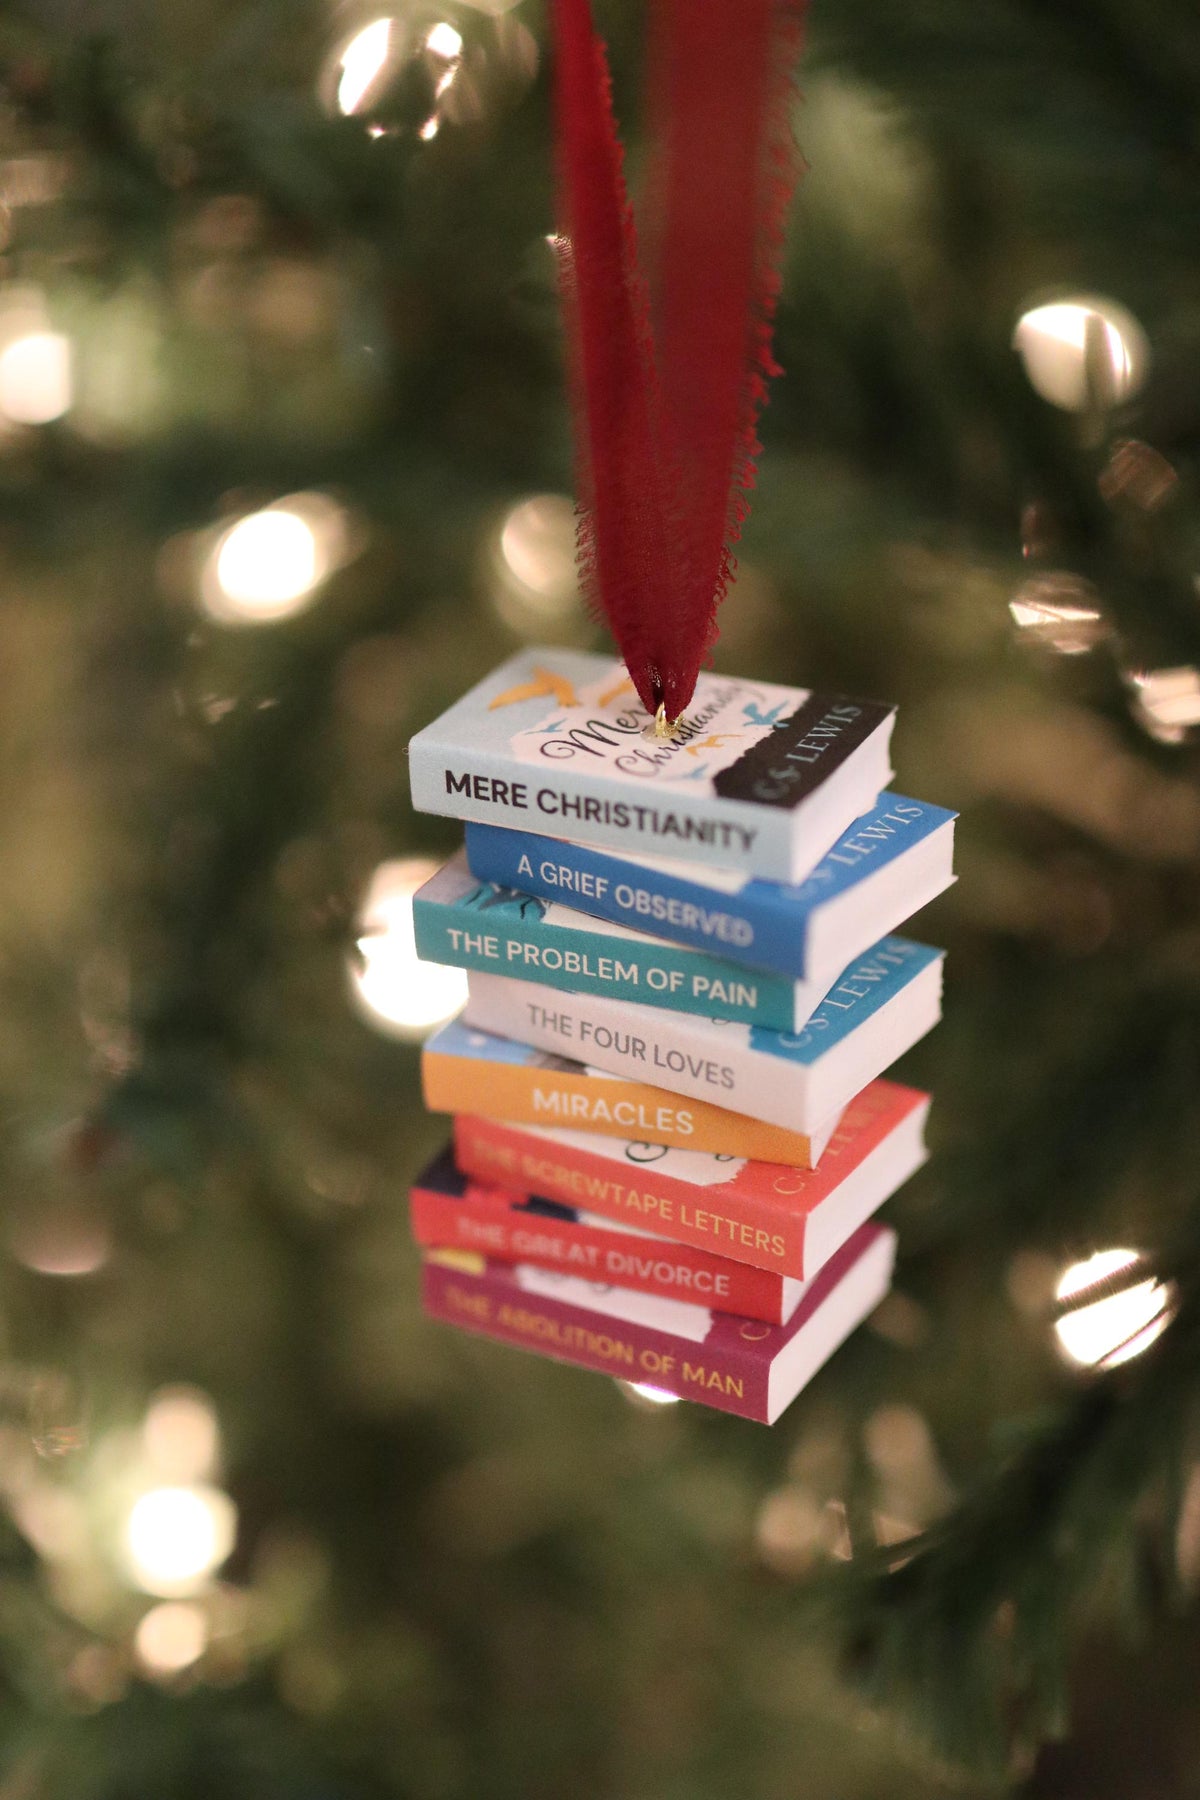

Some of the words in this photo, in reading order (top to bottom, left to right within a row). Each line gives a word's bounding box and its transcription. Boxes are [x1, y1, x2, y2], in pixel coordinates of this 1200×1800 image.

[540, 700, 646, 759] Mer
[785, 705, 861, 763] LEWIS
[445, 769, 528, 809] MERE
[536, 788, 757, 852] CHRISTIANITY
[826, 804, 924, 866] LEWIS
[517, 854, 534, 878] A
[540, 862, 609, 899] GRIEF
[614, 885, 754, 947] OBSERVED
[447, 928, 500, 959] THE
[506, 940, 639, 985] PROBLEM
[646, 968, 685, 992] OF
[692, 975, 757, 1008] PAIN
[527, 1003, 572, 1037] THE
[580, 1021, 646, 1062] FOUR
[653, 1044, 736, 1089] LOVES
[532, 1087, 695, 1134] MIRACLES
[521, 1154, 673, 1221] SCREWTAPE
[680, 1204, 786, 1257] LETTERS
[512, 1230, 599, 1268] GREAT
[606, 1250, 730, 1296] DIVORCE
[498, 1304, 634, 1367] ABOLITION
[639, 1348, 676, 1376] OF
[682, 1361, 745, 1399] MAN
